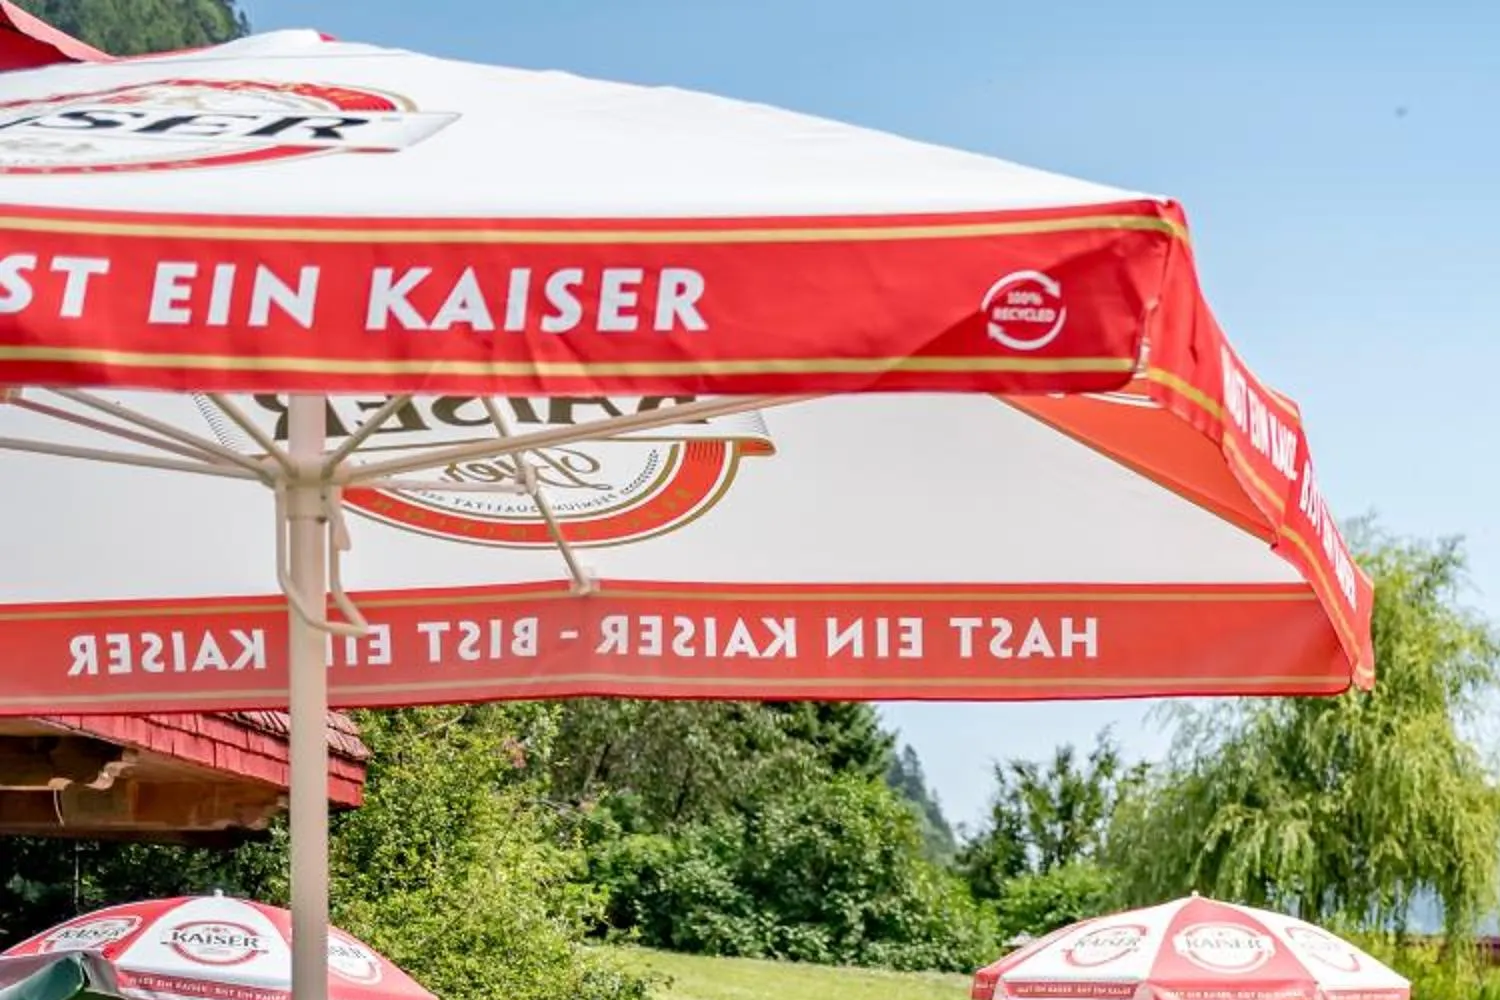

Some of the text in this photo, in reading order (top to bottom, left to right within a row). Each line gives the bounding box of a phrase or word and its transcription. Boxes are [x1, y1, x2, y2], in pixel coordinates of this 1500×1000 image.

[0, 110, 370, 142] SER
[147, 262, 320, 328] EIN
[364, 267, 709, 333] KAISER
[993, 307, 1056, 323] RECYCLED
[173, 931, 259, 948] KAISER
